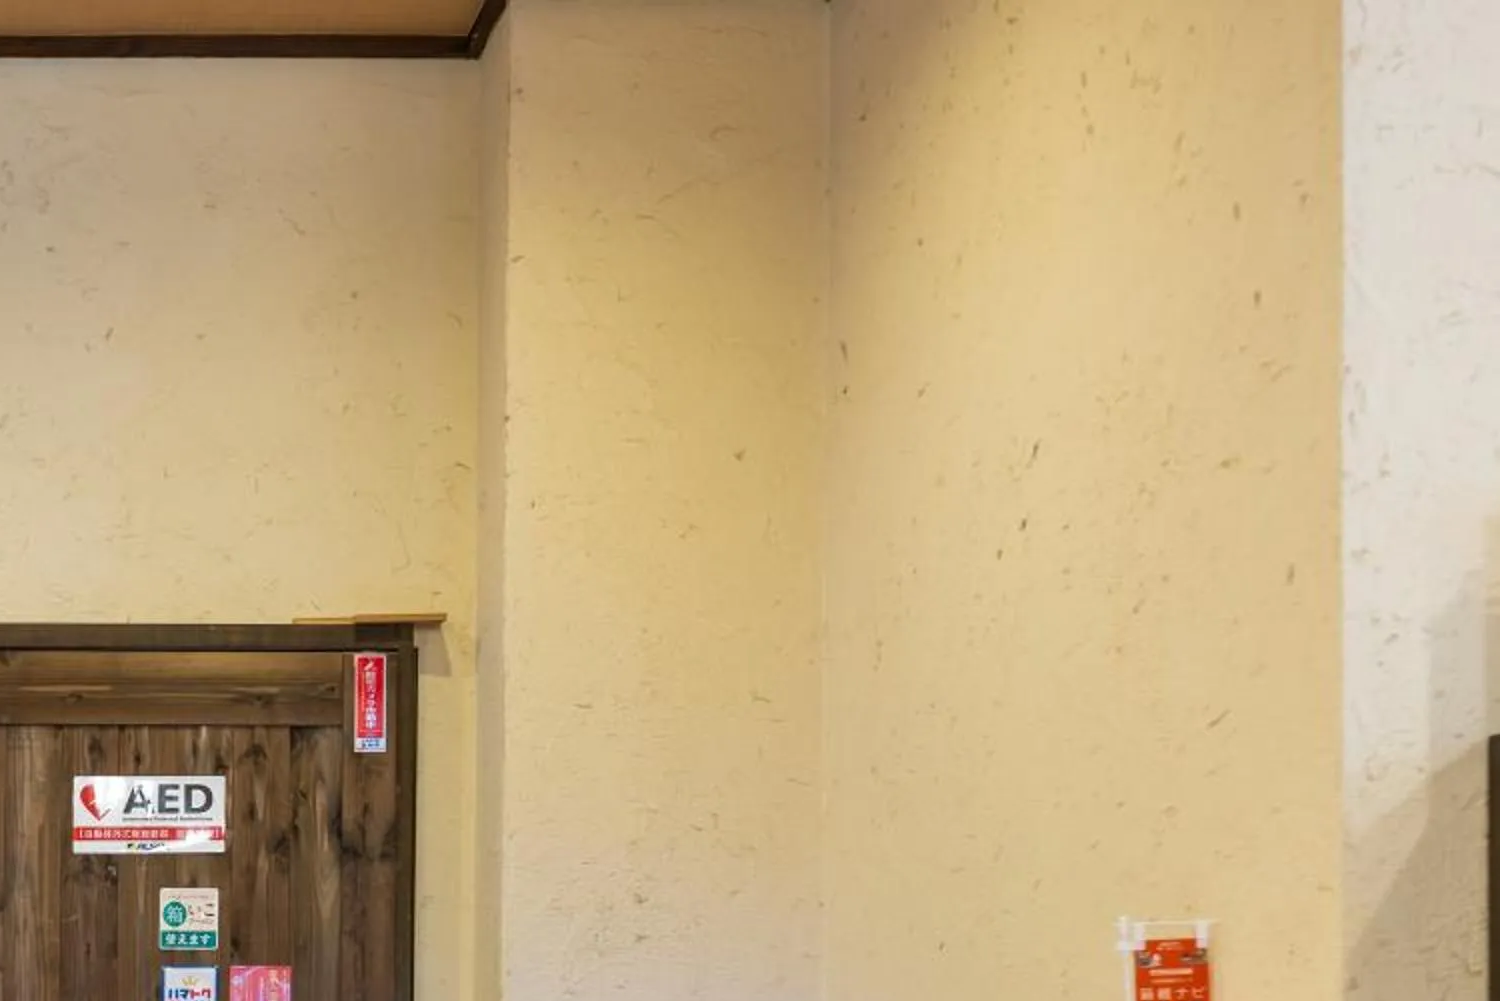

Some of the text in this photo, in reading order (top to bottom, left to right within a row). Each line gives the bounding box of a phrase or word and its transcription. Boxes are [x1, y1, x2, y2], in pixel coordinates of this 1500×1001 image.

[123, 784, 214, 814] AED
[165, 933, 212, 945] 使えます
[167, 988, 211, 999] ハマトク
